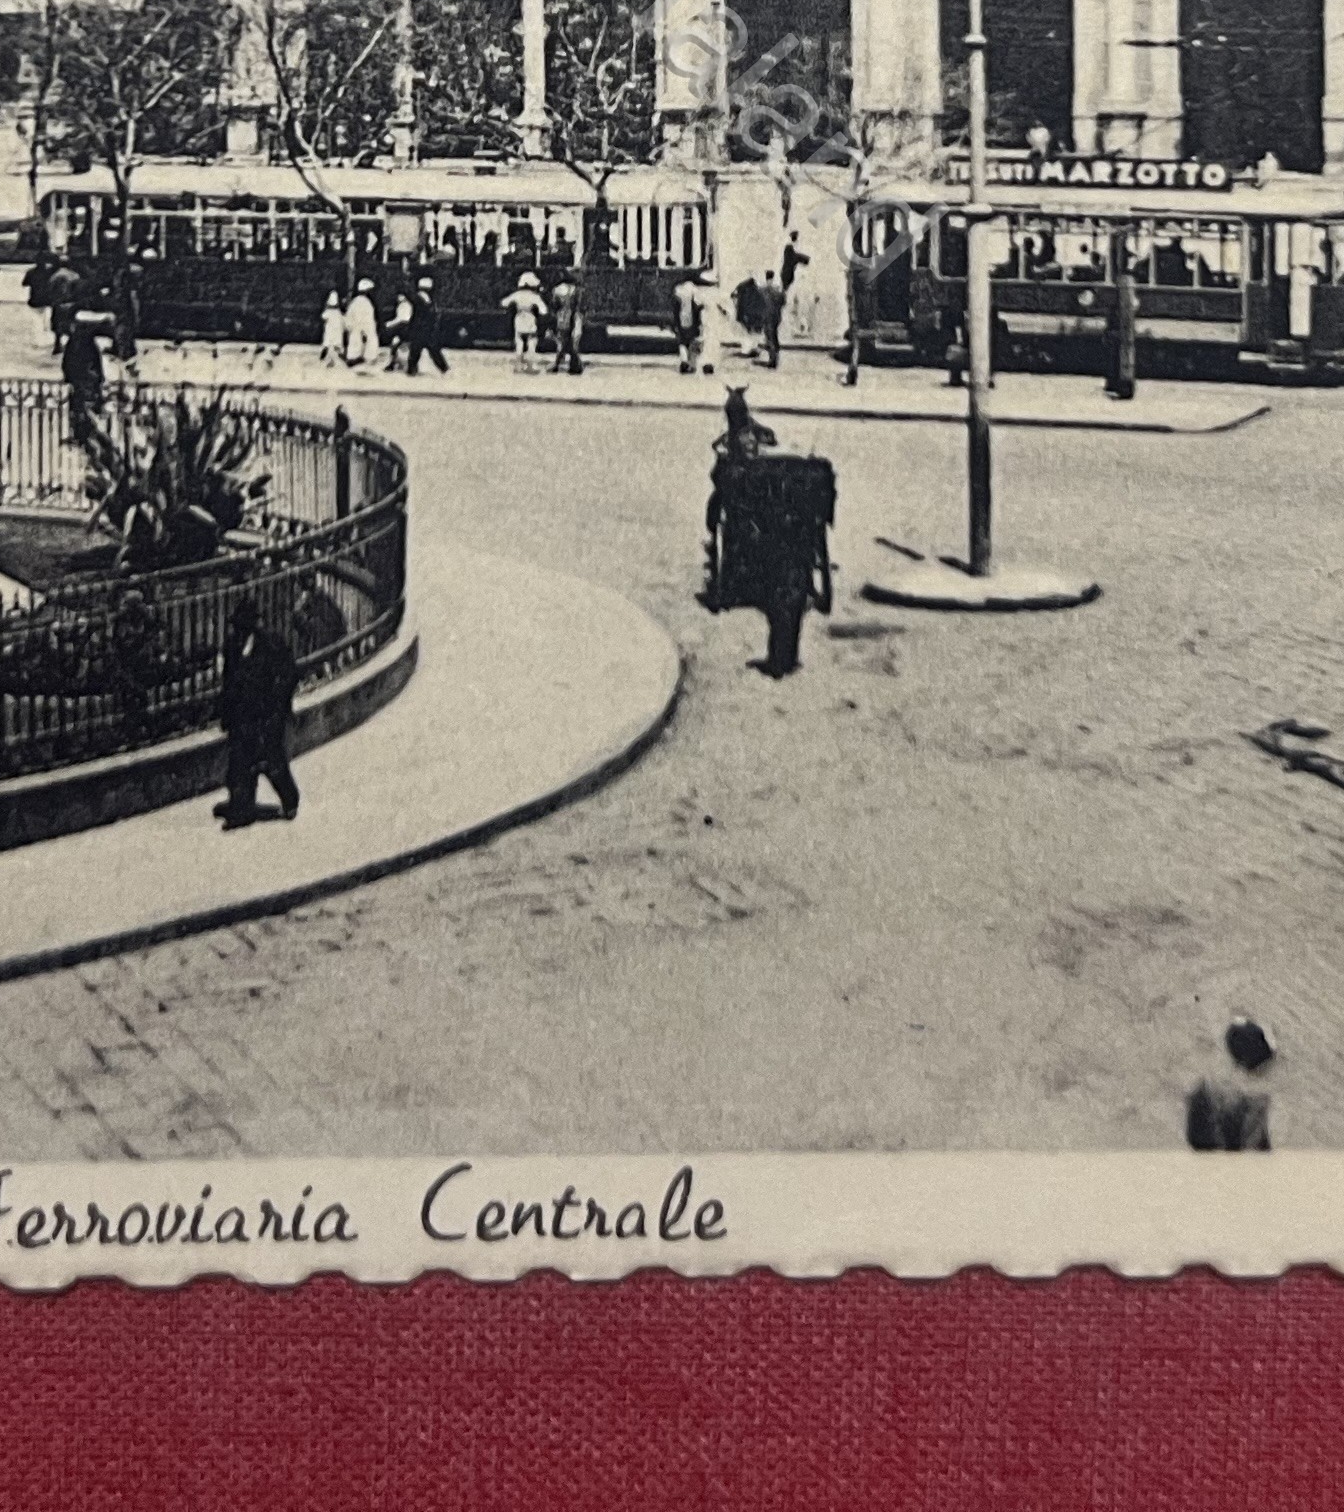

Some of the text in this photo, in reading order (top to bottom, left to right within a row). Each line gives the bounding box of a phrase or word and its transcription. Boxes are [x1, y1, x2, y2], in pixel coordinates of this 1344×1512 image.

[949, 160, 1227, 187] TESUTI MARZOTTO
[419, 1163, 728, 1243] Centrale
